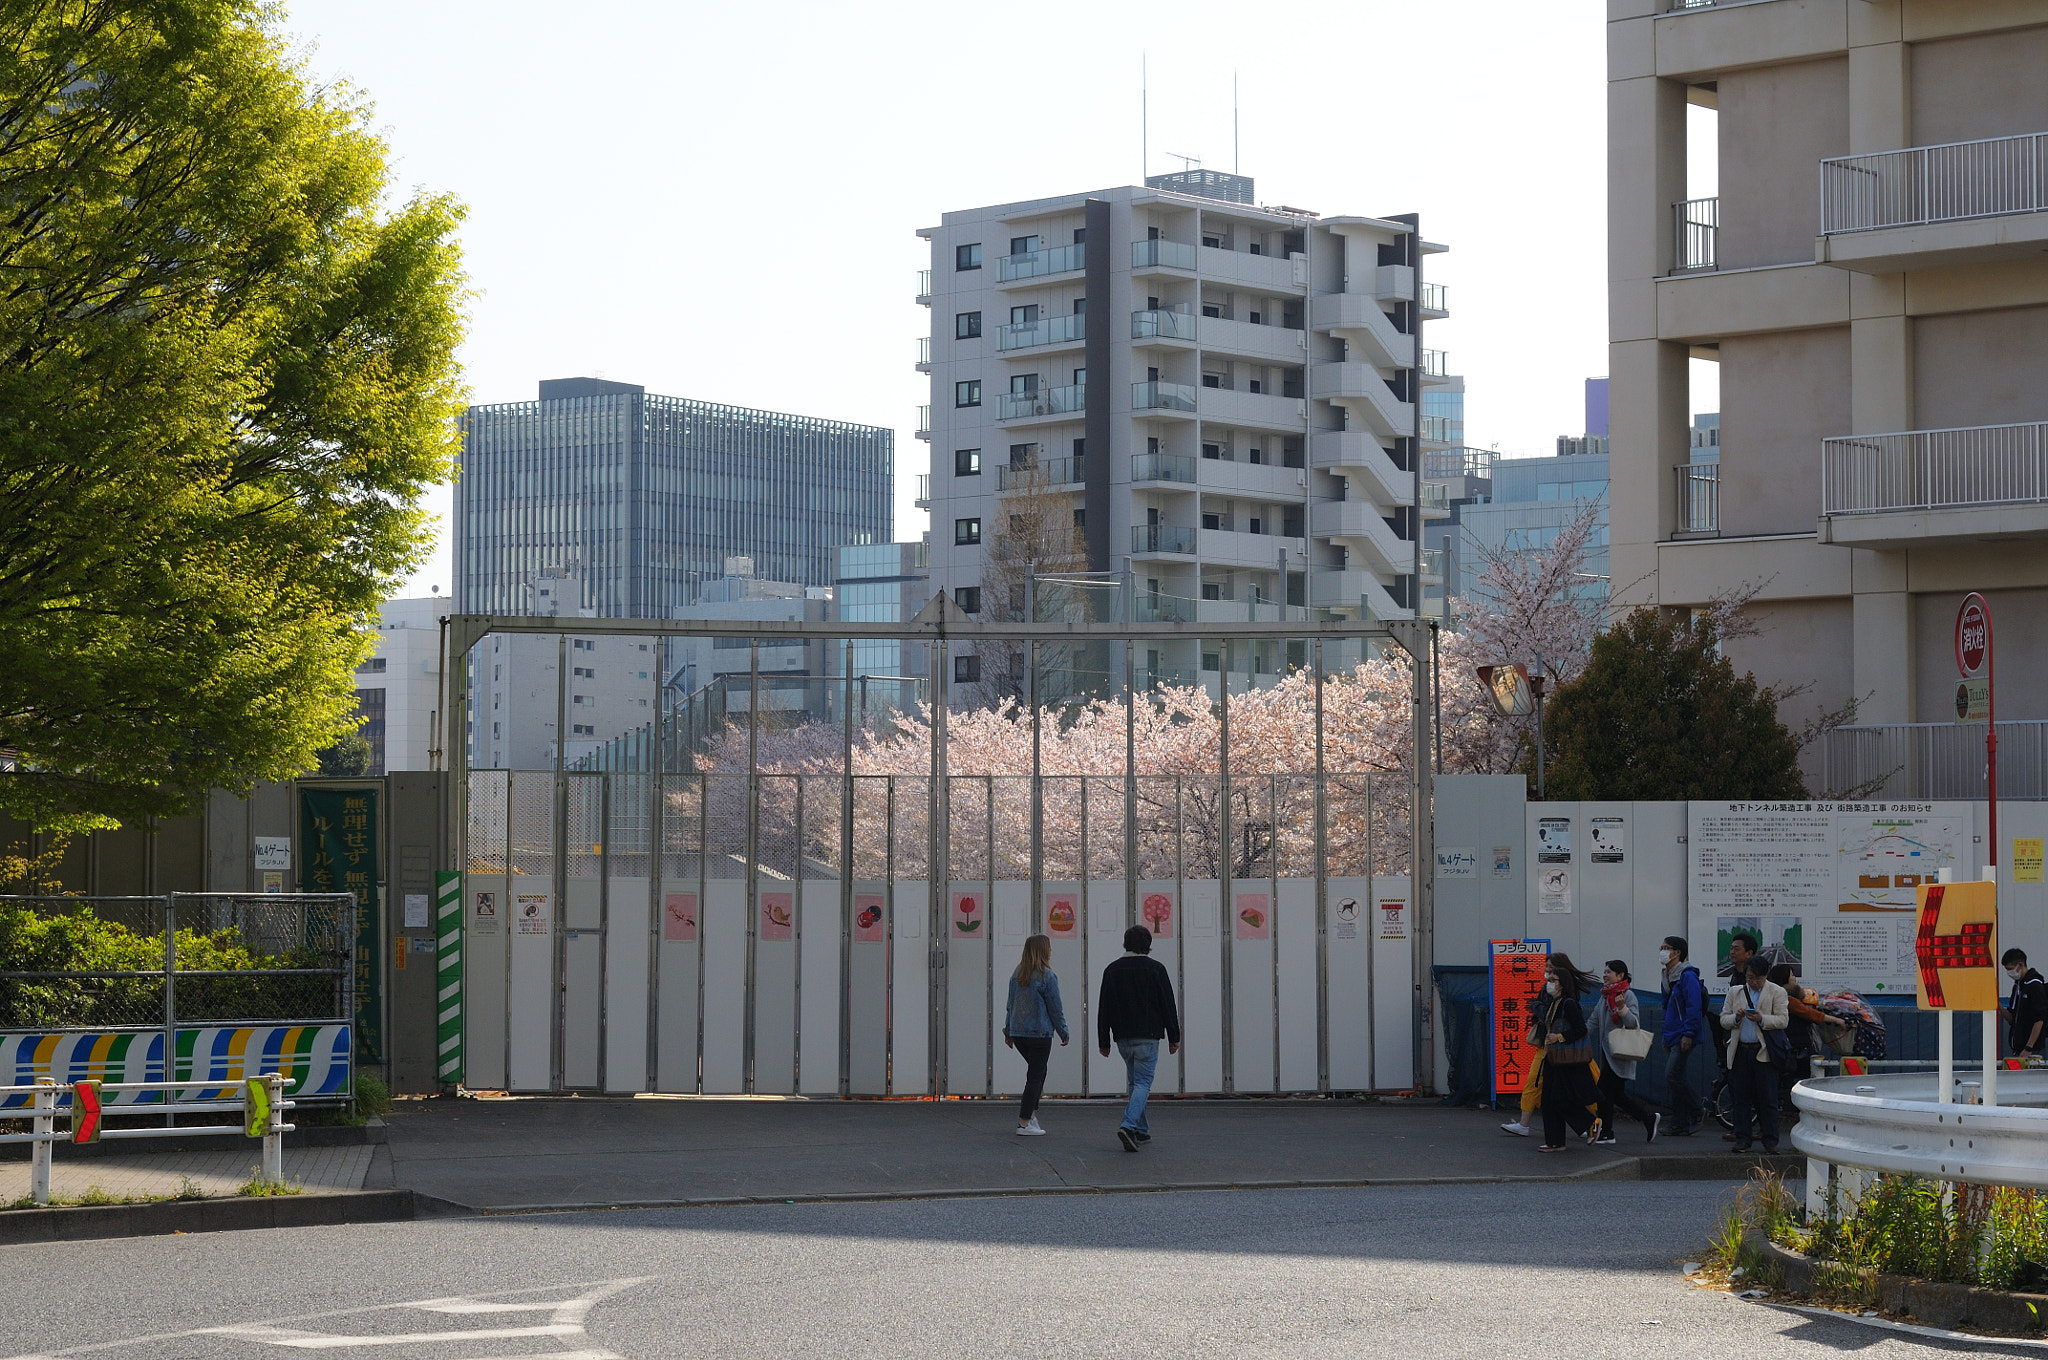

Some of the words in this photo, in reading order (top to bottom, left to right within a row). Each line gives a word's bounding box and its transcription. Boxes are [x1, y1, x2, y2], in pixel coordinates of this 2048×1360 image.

[1964, 625, 1984, 652] 消火栓
[1729, 803, 1812, 813] 地下トンネル築造工事
[1816, 803, 1833, 813] 及び
[1890, 803, 1932, 813] のお知らせ
[343, 797, 369, 867] 無理せず
[1498, 943, 1542, 954] フジタJV
[1501, 997, 1520, 1086] 車両出入口
